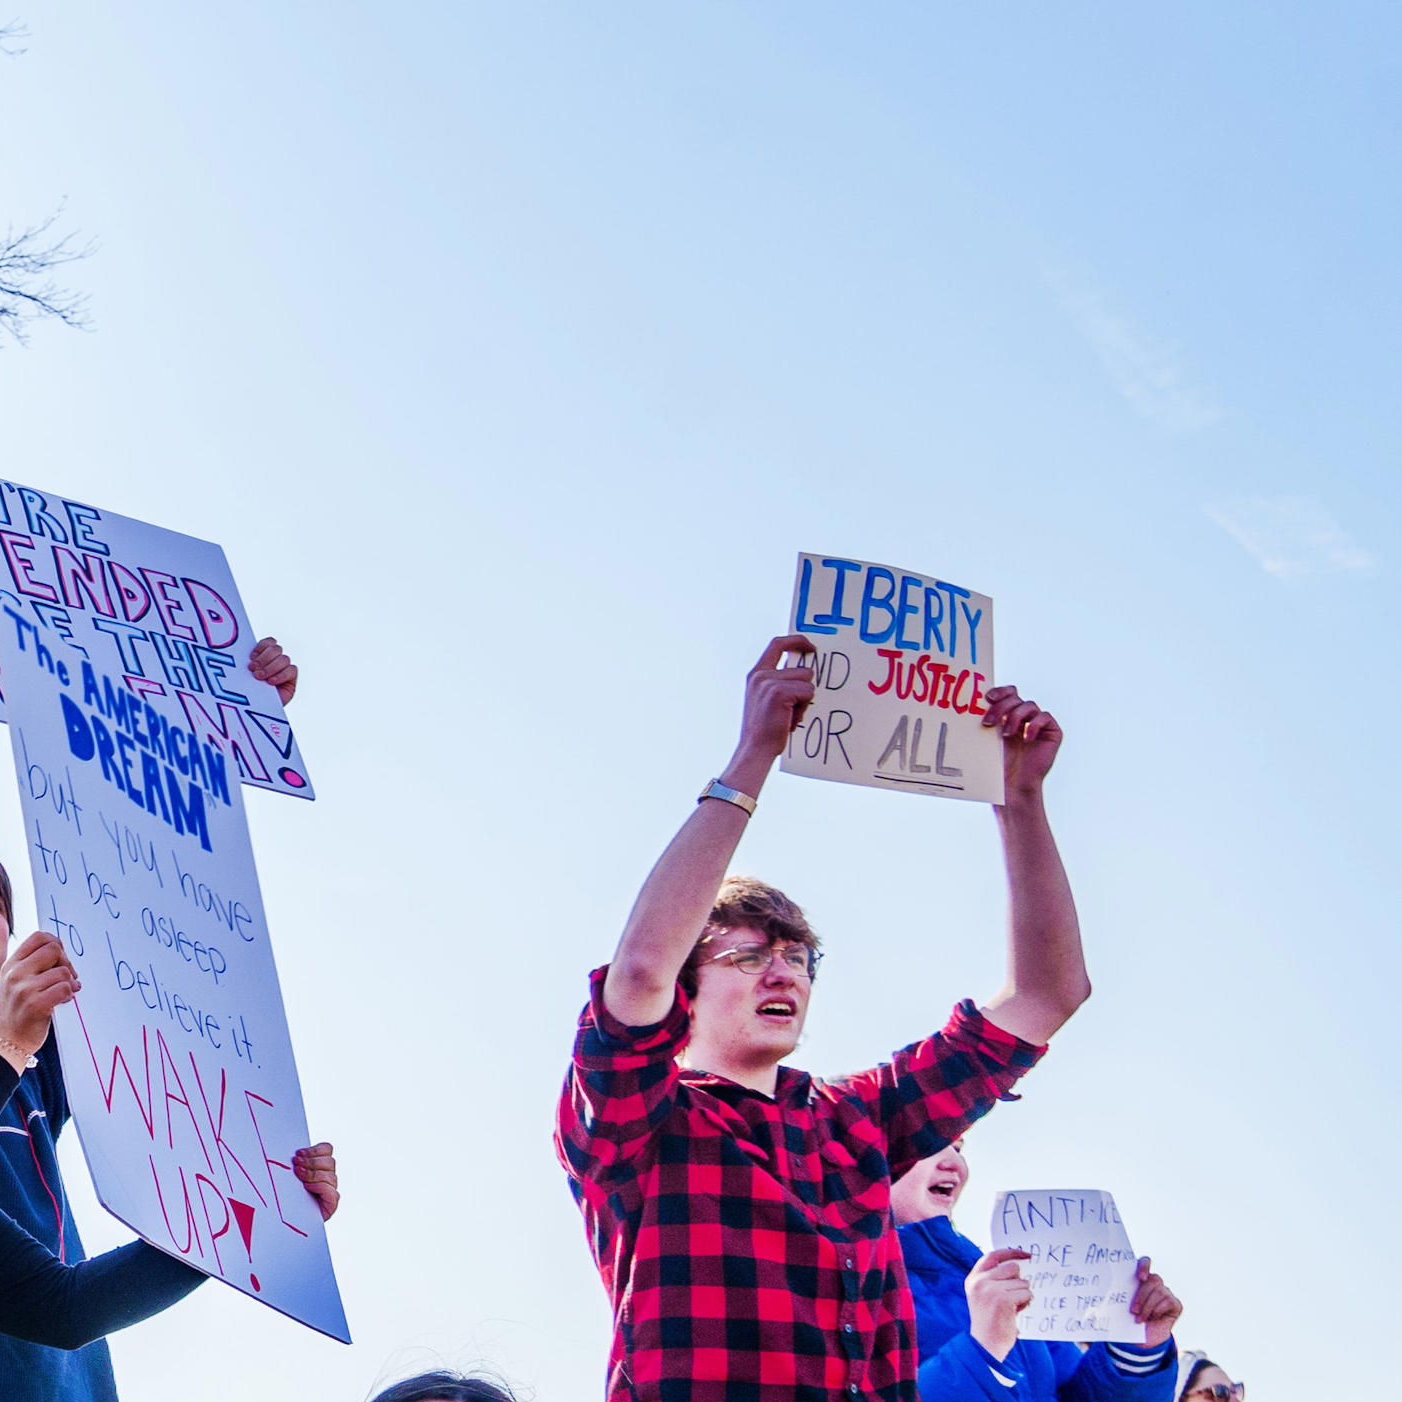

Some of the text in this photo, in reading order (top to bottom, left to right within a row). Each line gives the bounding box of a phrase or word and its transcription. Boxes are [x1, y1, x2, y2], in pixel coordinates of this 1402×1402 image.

[3, 604, 71, 687] The
[93, 618, 249, 705] THE
[796, 558, 982, 664] LIBERTY
[81, 660, 232, 807] AMERICAN
[868, 648, 988, 715] JUSTICE
[877, 714, 963, 777] ALL
[19, 728, 83, 836] but
[172, 850, 255, 942] have
[35, 818, 227, 984] to be asleep
[49, 894, 83, 956] to
[106, 930, 221, 1049] believe
[72, 994, 307, 1236] WAKE
[149, 1153, 262, 1292] UP!
